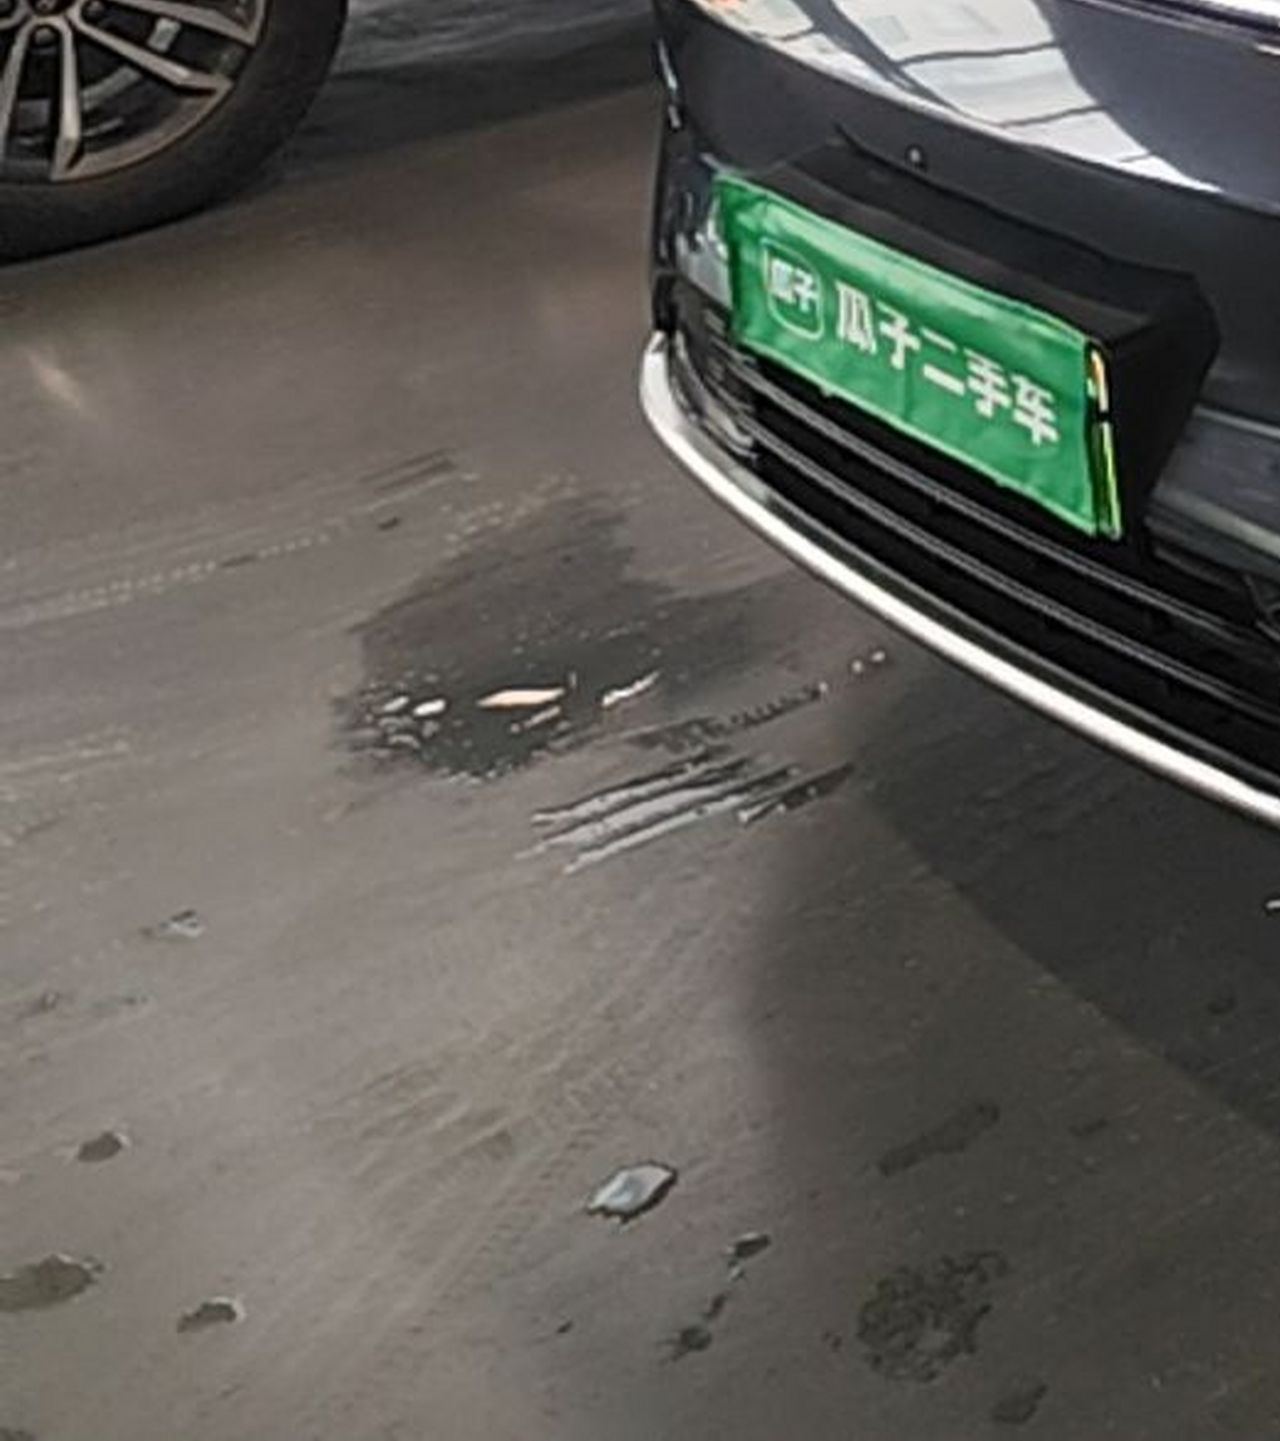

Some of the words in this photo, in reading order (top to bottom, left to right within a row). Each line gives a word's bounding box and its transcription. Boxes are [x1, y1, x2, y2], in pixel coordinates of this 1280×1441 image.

[834, 278, 1060, 447] 瓜子二手车
